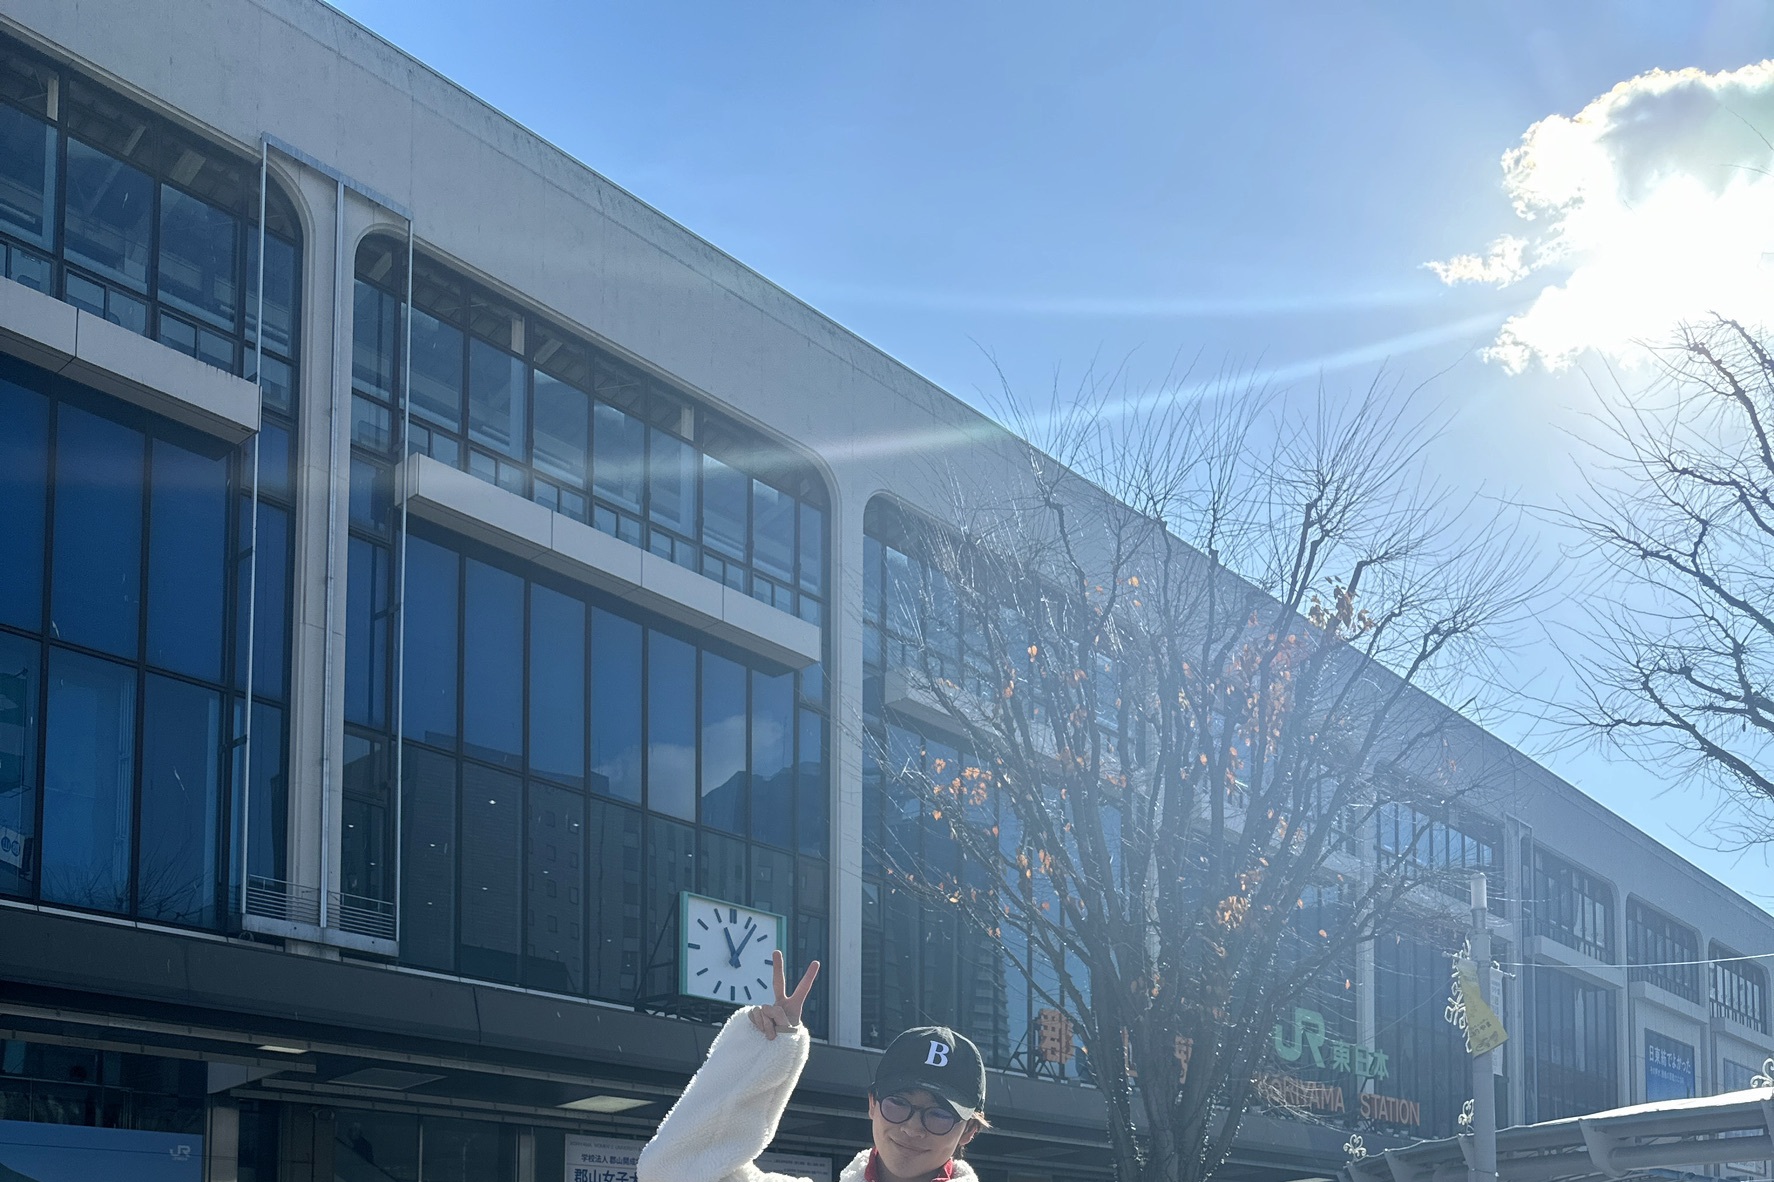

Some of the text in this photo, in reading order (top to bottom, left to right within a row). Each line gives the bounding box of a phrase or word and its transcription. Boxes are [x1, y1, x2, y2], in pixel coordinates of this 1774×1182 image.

[924, 1040, 950, 1067] B
[1274, 1007, 1389, 1081] JR 東日本
[1360, 1093, 1421, 1127] STATION
